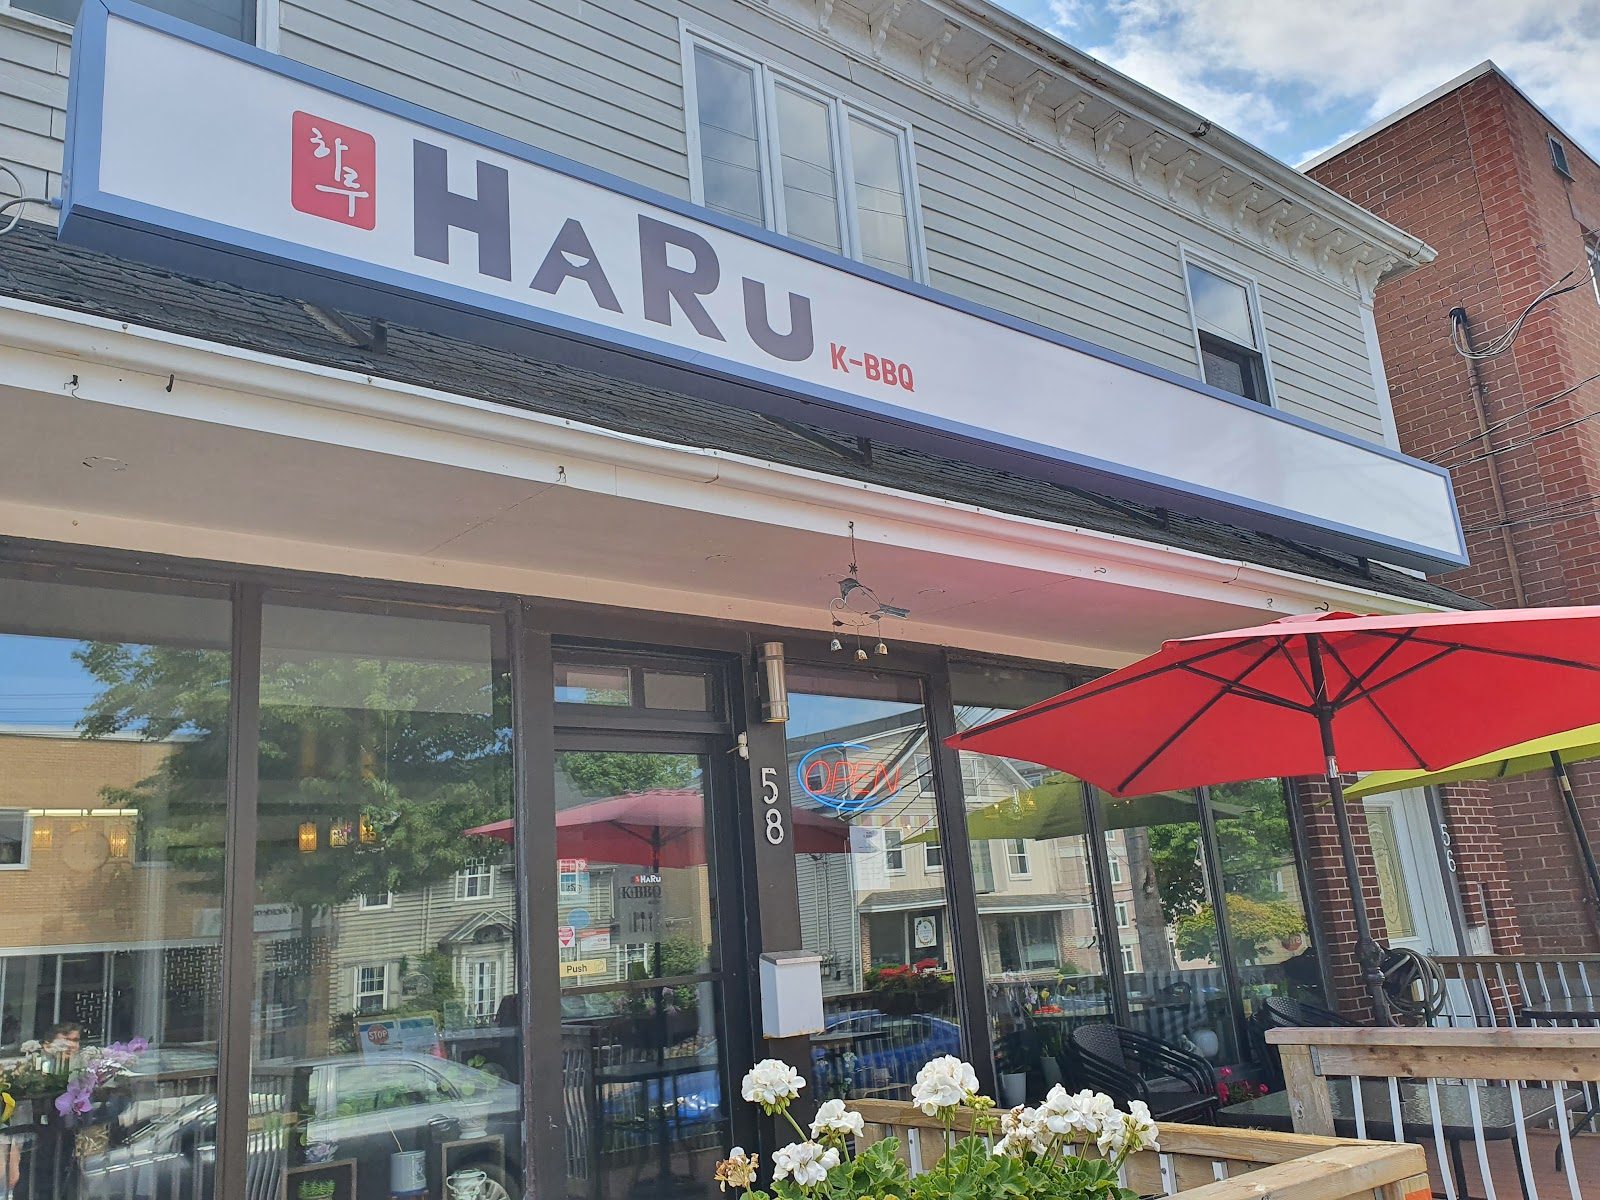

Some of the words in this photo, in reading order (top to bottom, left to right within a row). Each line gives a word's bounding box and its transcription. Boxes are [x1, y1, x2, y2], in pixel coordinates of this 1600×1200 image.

[309, 127, 370, 218] 하루
[829, 342, 915, 393] K-BBQ
[804, 760, 901, 795] OPEN
[761, 767, 785, 845] 58
[1440, 823, 1457, 873] 56
[566, 964, 588, 974] Push
[367, 1029, 388, 1041] STOP
